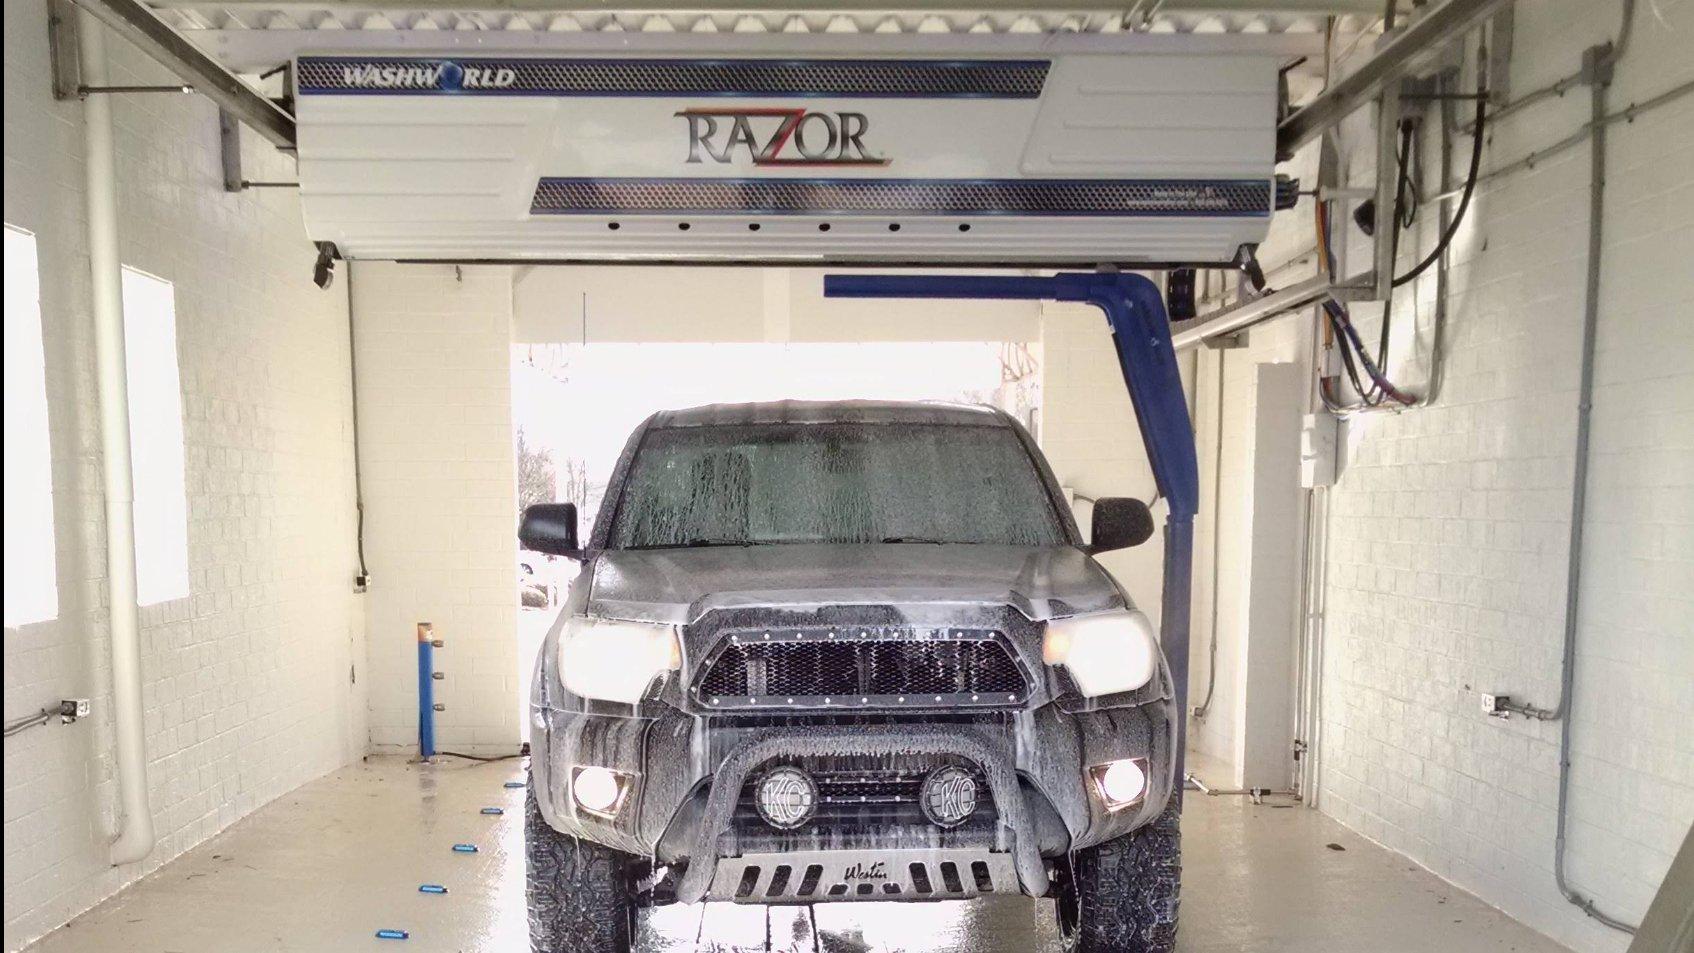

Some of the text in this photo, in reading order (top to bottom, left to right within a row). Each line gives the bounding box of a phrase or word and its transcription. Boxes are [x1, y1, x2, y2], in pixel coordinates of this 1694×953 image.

[674, 108, 893, 167] RAZOR
[766, 777, 806, 822] KC
[941, 776, 976, 819] KC
[844, 862, 888, 881] Westin
